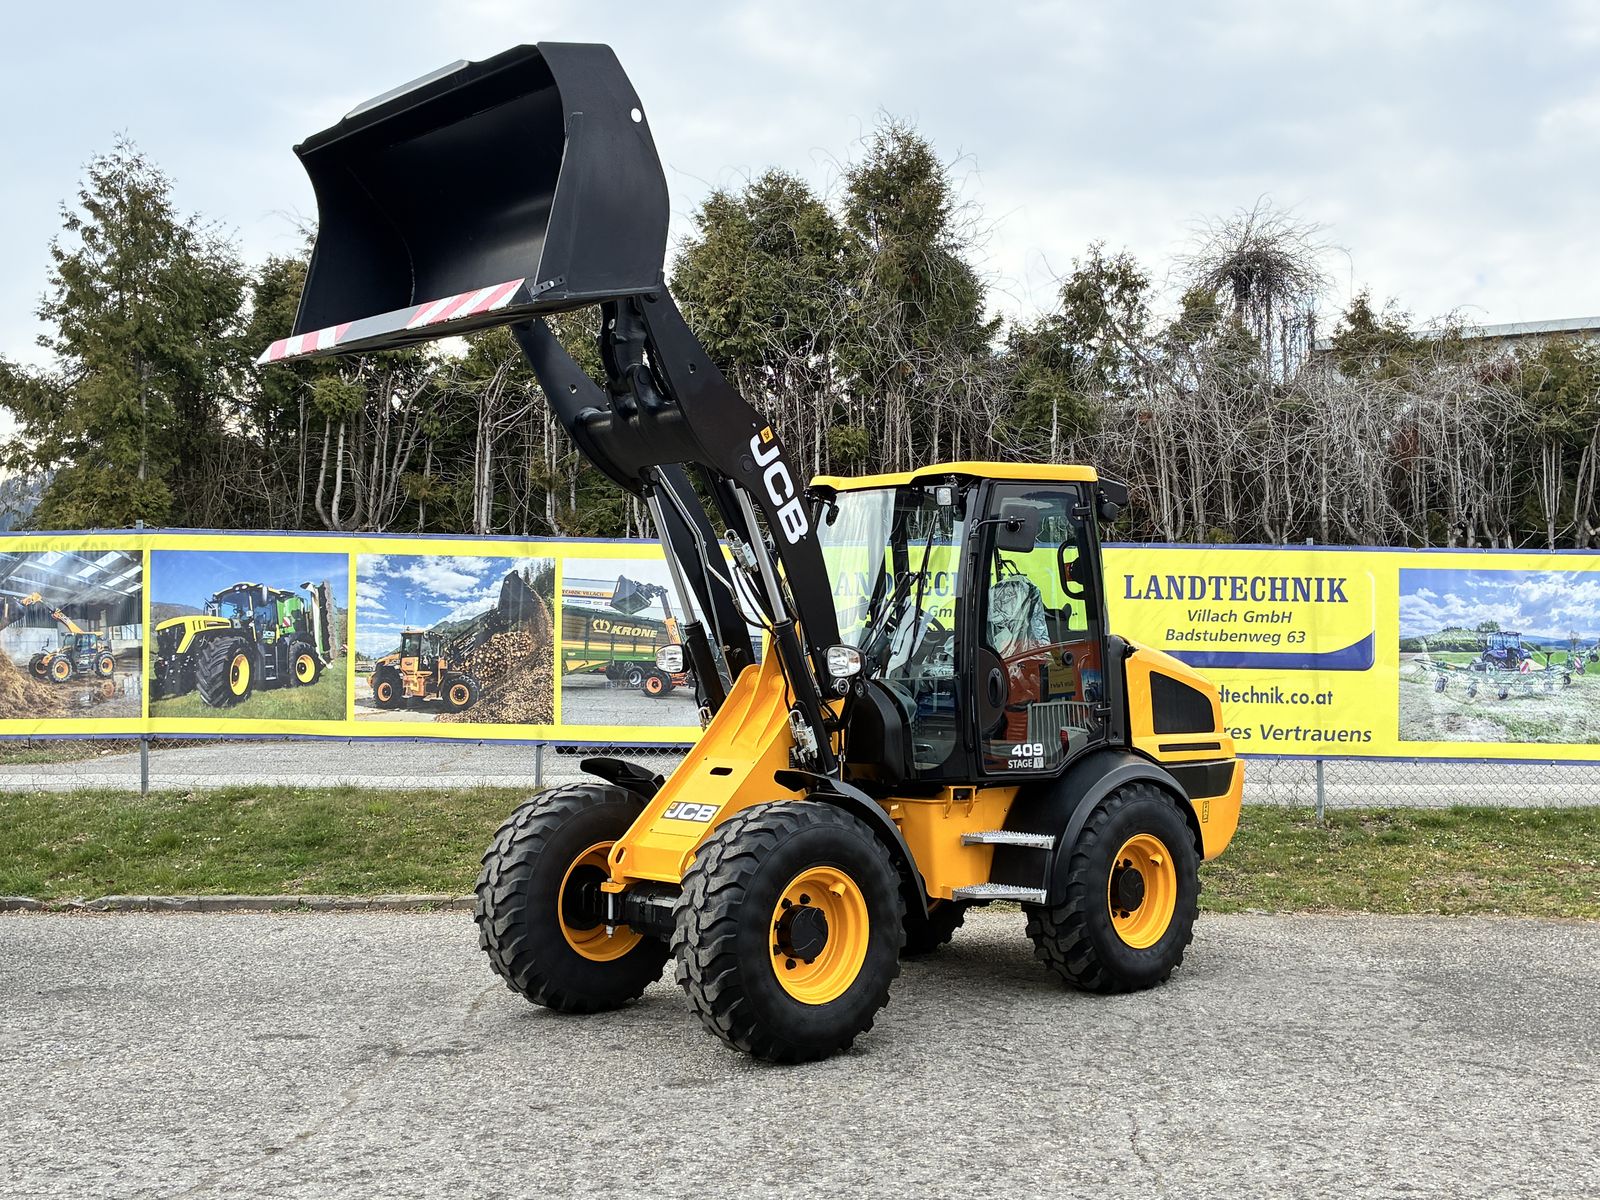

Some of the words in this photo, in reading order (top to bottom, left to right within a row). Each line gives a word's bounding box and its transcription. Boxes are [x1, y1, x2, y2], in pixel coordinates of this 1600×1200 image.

[750, 434, 809, 545] JCB
[1123, 575, 1349, 603] LANDTECHNIK
[1187, 609, 1238, 624] Villach
[1243, 610, 1293, 624] GmbH
[610, 624, 659, 639] KRONE
[1165, 629, 1281, 646] Badstubenweg
[1286, 631, 1306, 644] 63
[1218, 685, 1333, 706] dtechnik.co.at
[1260, 724, 1373, 743] Vertrauens
[1011, 743, 1044, 757] 409
[1008, 758, 1033, 769] STAGE
[663, 802, 718, 822] JCB
